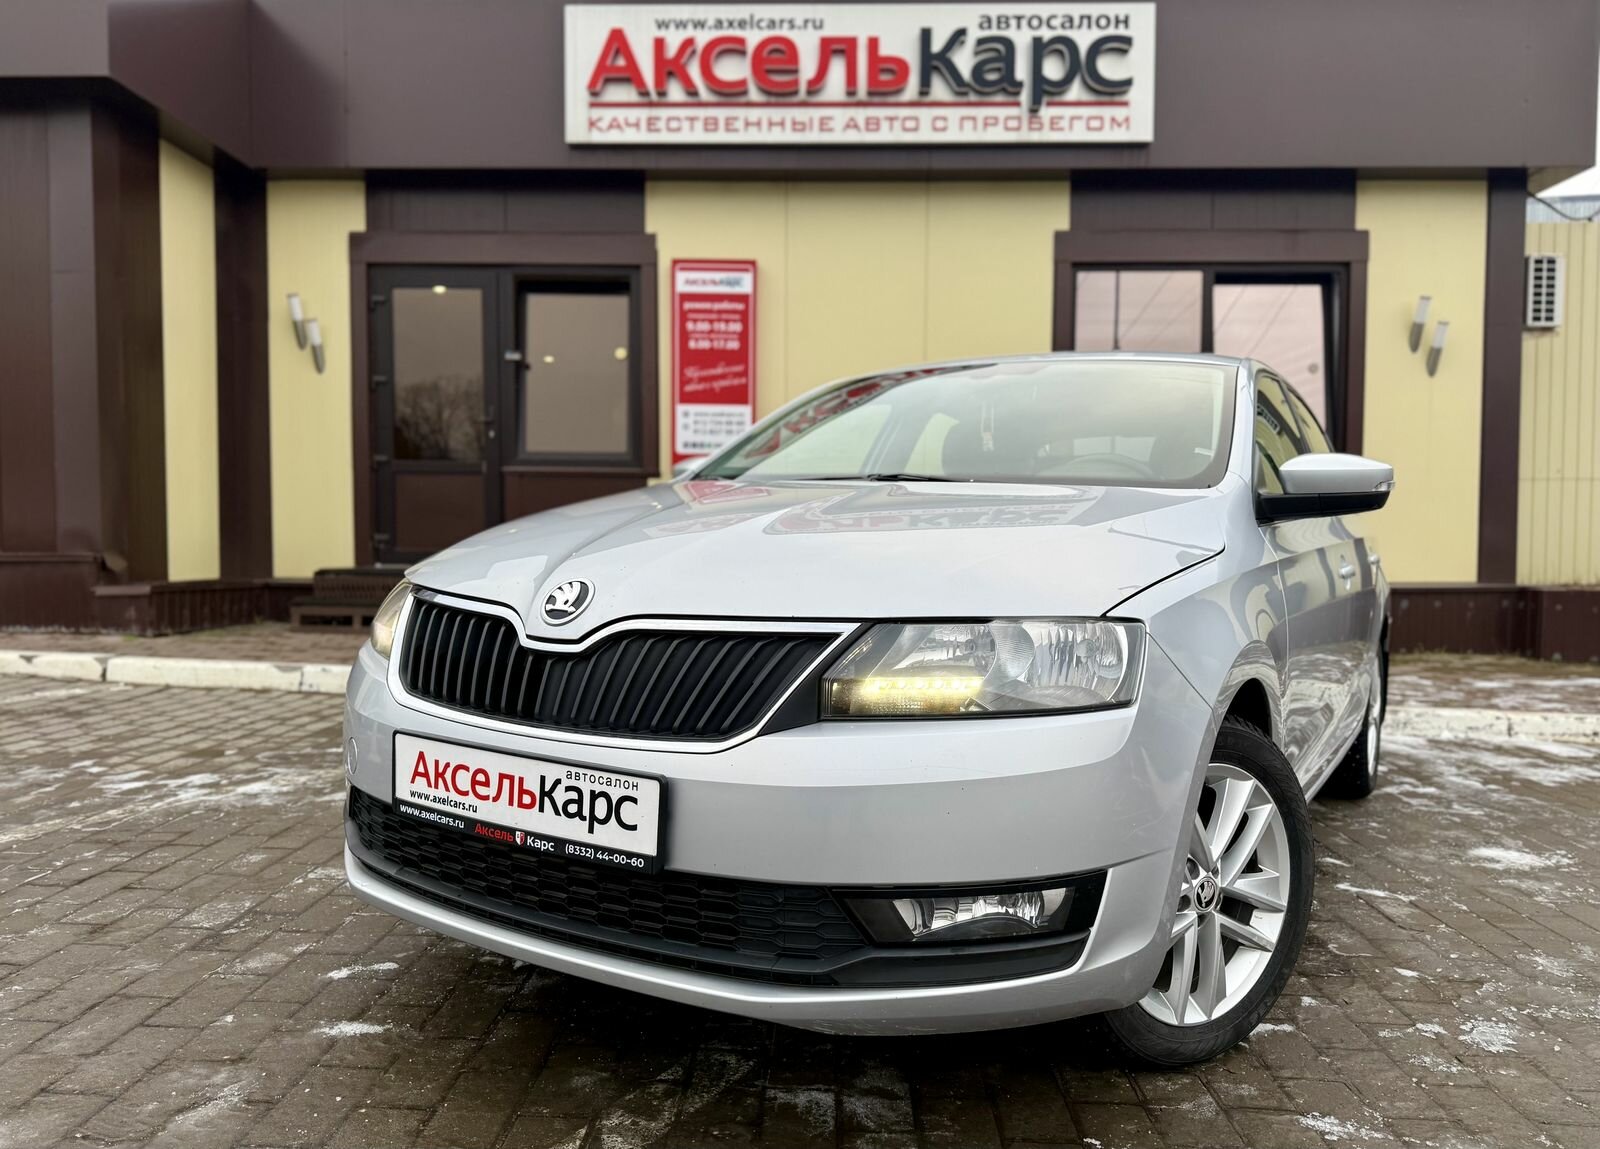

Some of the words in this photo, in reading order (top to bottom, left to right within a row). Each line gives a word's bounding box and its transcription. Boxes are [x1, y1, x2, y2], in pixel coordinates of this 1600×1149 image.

[655, 15, 825, 31] www.axelcars.ru
[978, 13, 1130, 31] автосалон
[588, 27, 1133, 111] АксельКарс
[588, 116, 835, 133] КАЧЕСТВЕННЫЕ
[842, 116, 920, 133] АВТО
[931, 116, 948, 132] С
[960, 115, 1130, 132] ПРОБЕГОМ
[410, 751, 638, 834] АксельКарс
[566, 770, 639, 791] автосалон
[409, 789, 478, 814] www.axelcars.ru
[399, 803, 465, 829] www.axelcars.ru
[474, 823, 514, 842] Аксель
[527, 836, 555, 852] Карс
[565, 844, 595, 859] (8332)
[596, 851, 645, 868] 44-00-60
